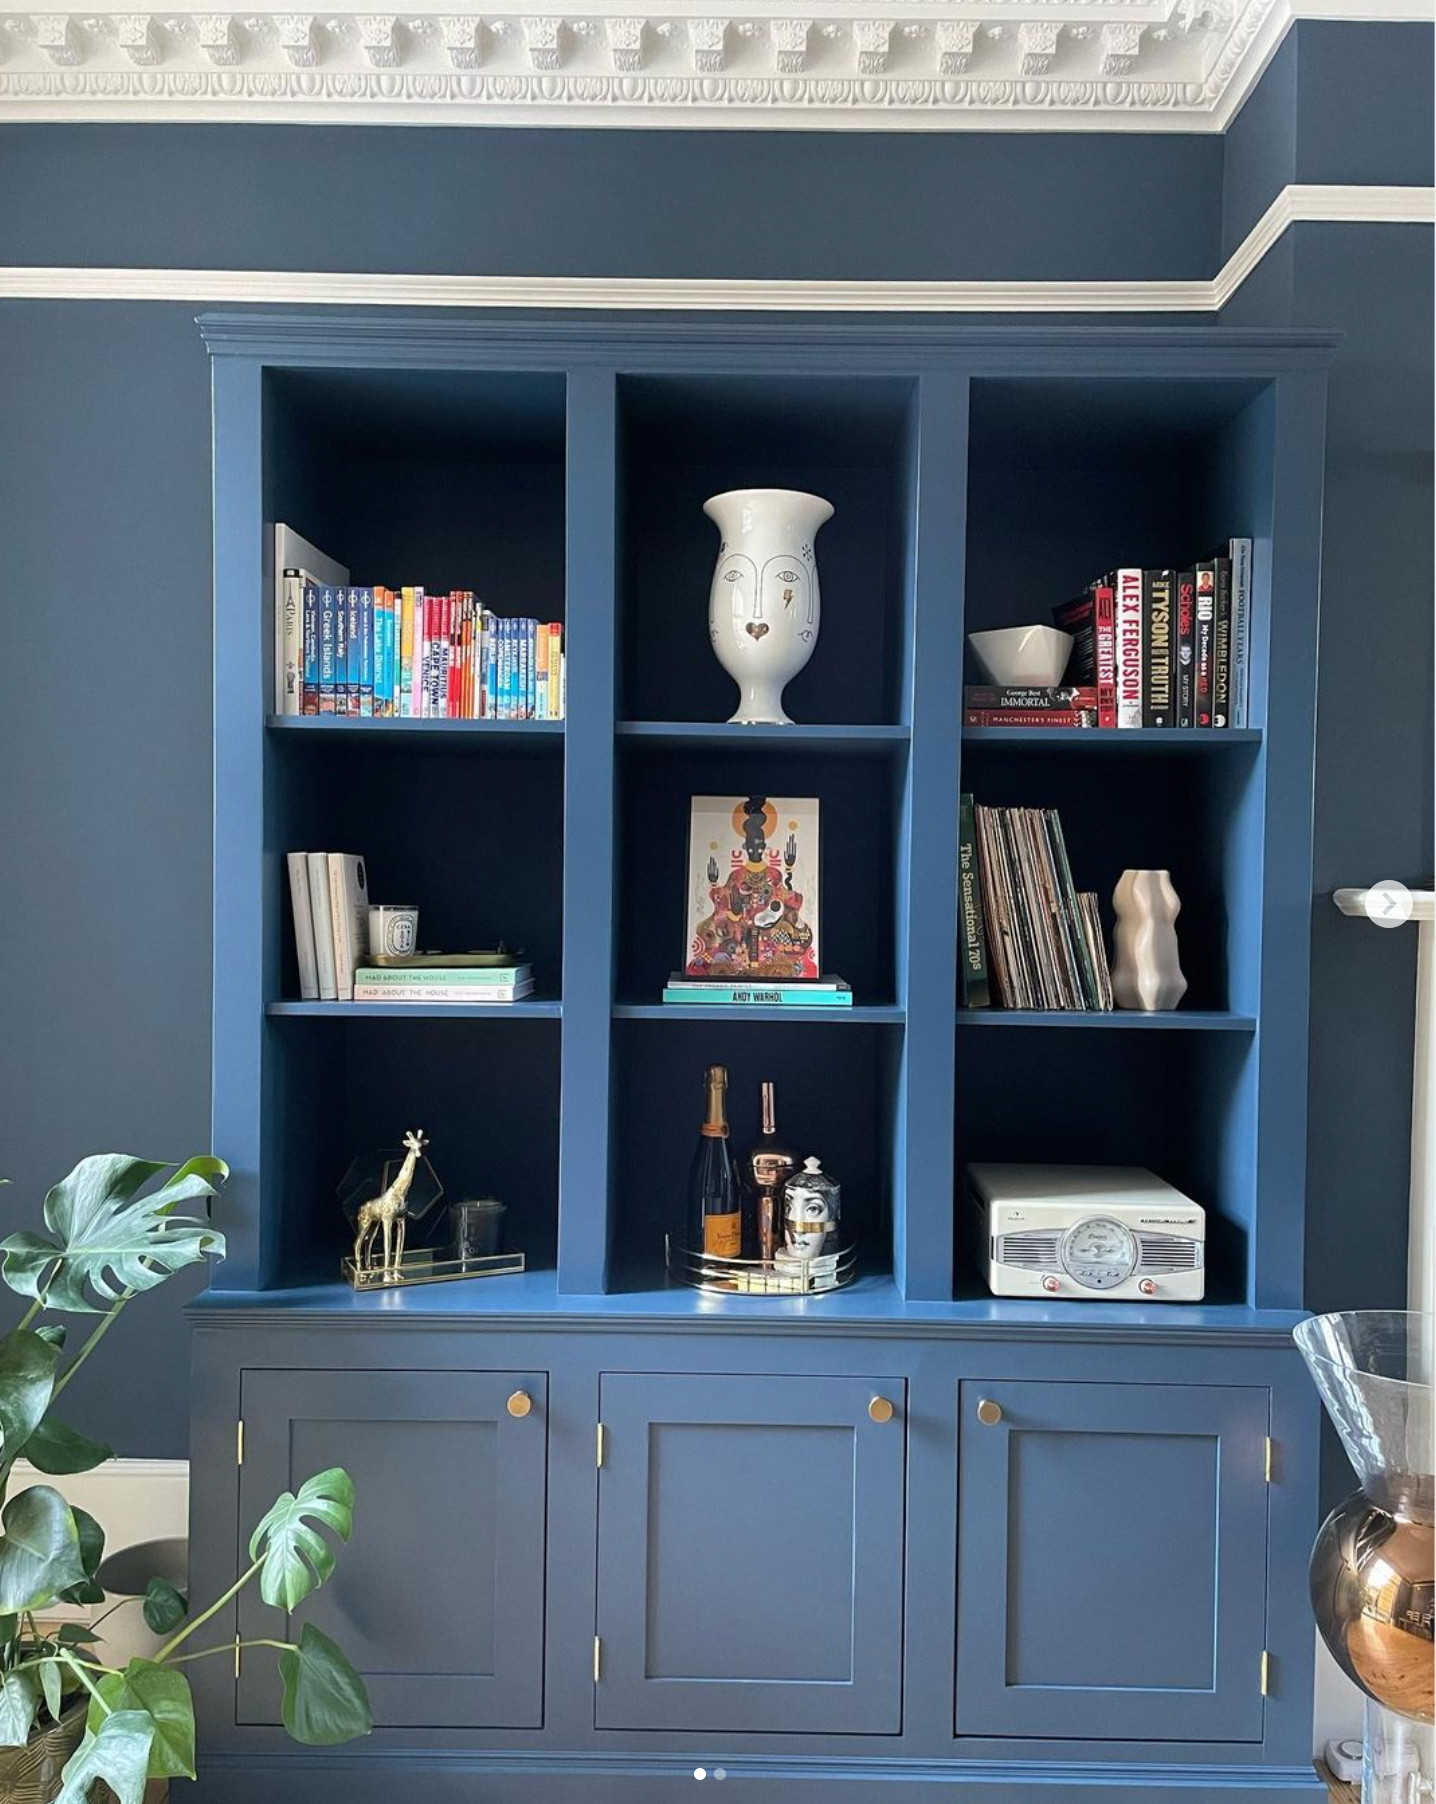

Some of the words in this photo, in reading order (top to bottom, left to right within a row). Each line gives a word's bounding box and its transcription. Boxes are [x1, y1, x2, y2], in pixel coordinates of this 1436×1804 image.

[1122, 574, 1139, 614] ALEX
[1197, 596, 1213, 621] RIO
[286, 608, 296, 636] PARIS
[349, 610, 357, 639] Iceland
[1151, 589, 1170, 647] TYSON
[1180, 583, 1193, 636] Scholes
[1237, 589, 1245, 635] FOOTBALL
[323, 610, 333, 641] Greek
[323, 643, 333, 680] Islands
[336, 643, 345, 658] Italy
[430, 641, 440, 671] CAPE
[1098, 633, 1113, 684] GREATEST
[1122, 619, 1139, 700] FERGUSON
[1201, 636, 1209, 661] Decade
[1216, 619, 1229, 704] WIMBLEDON
[1236, 635, 1244, 665] YEARS
[423, 656, 431, 692] VENICE
[440, 648, 448, 699] MAURITIUS
[1182, 674, 1189, 684] MY
[430, 673, 440, 705] TOWN
[1000, 696, 1051, 707] IMMORTAL
[1006, 689, 1028, 697] George
[960, 843, 973, 870] The
[961, 872, 980, 948] Sensational
[968, 949, 982, 970] 70s
[732, 992, 751, 1002] ANDY
[753, 992, 783, 1003] WARHOL
